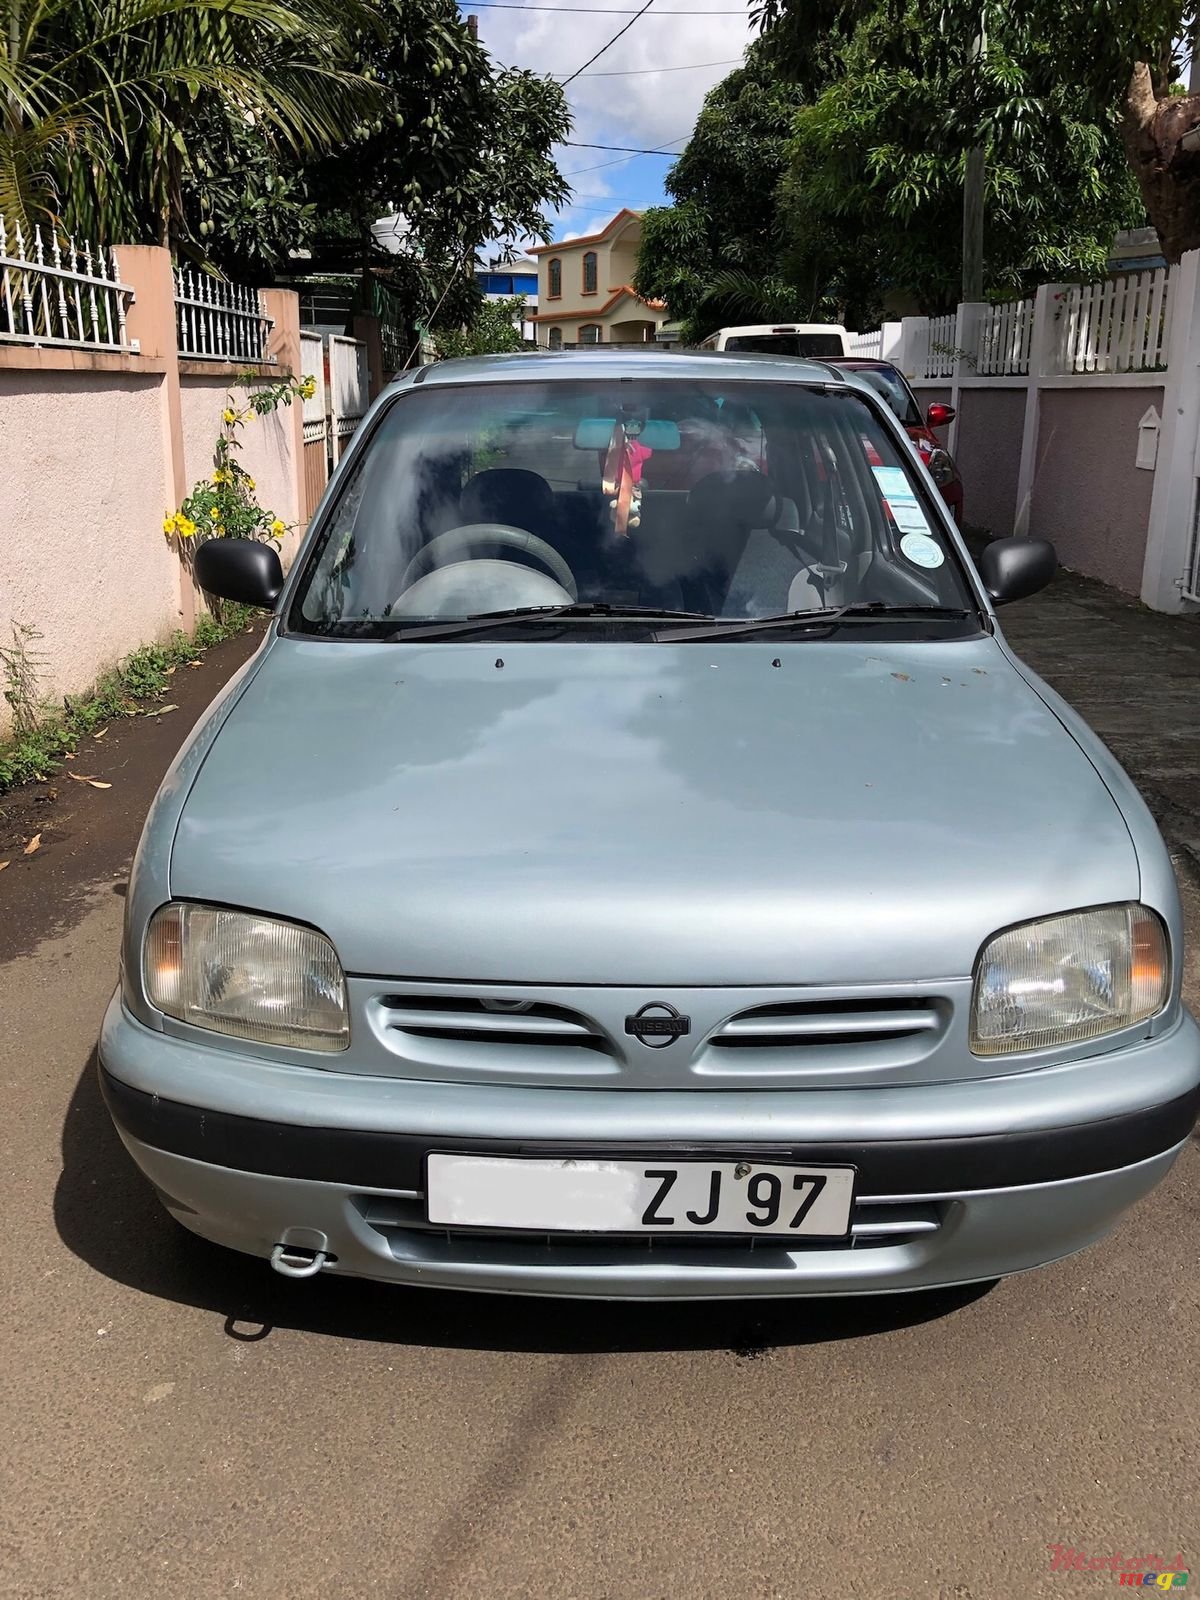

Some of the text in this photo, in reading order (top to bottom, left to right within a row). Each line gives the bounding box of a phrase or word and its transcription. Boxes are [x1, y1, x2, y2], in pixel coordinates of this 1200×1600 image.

[632, 1022, 682, 1032] NISSAN
[641, 1169, 828, 1229] ZJ 97
